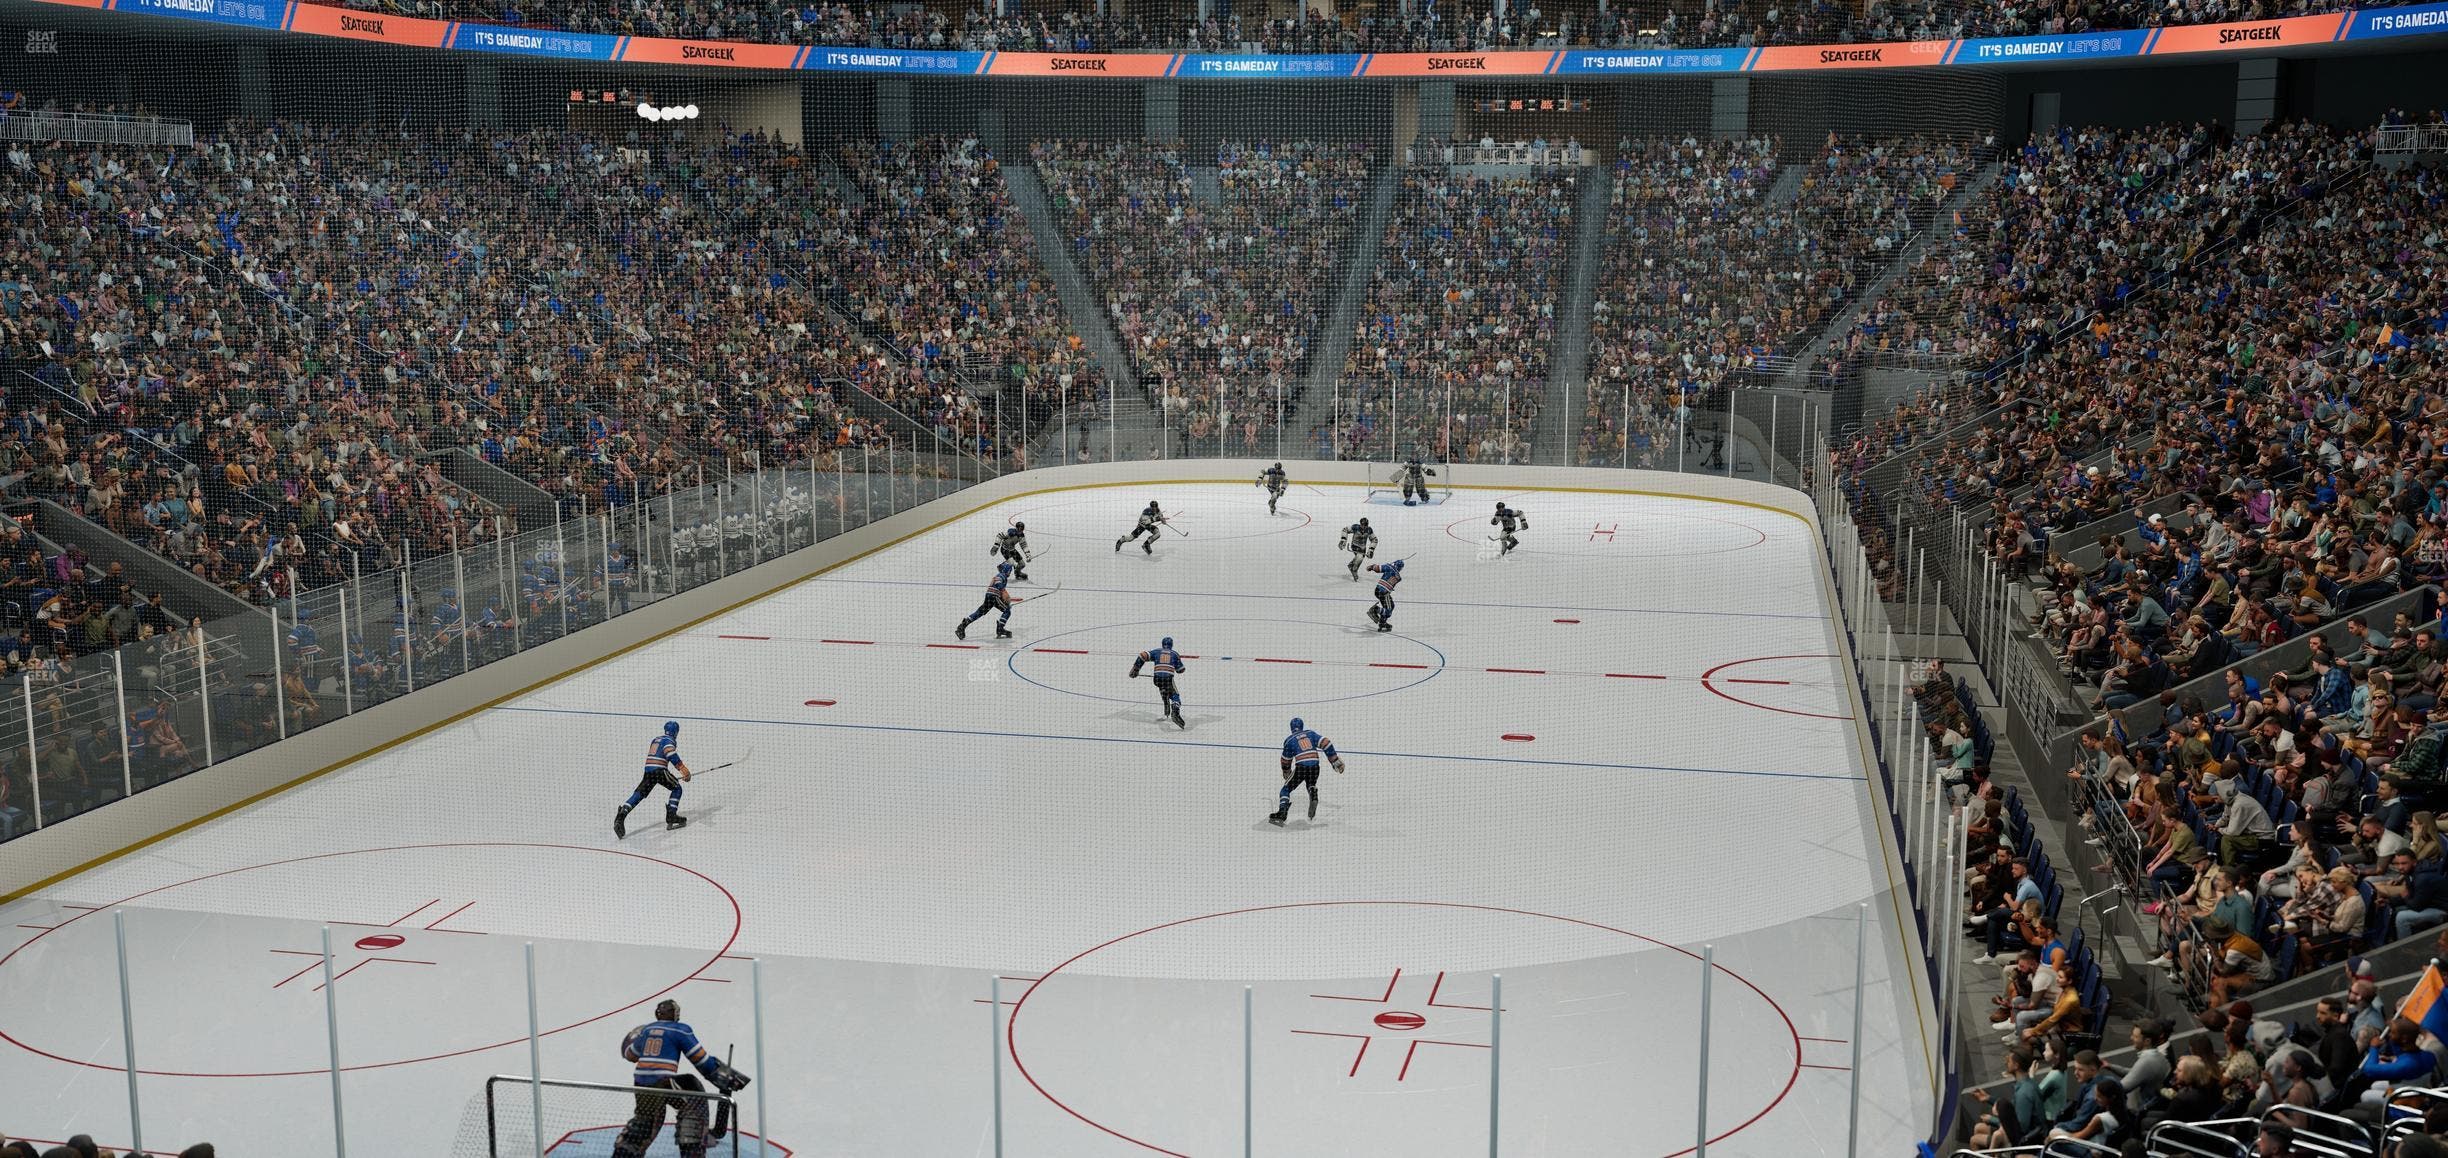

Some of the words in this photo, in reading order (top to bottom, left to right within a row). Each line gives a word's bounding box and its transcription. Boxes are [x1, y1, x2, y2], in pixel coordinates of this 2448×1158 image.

[218, 1, 245, 18] LET'S
[247, 4, 265, 20] GO!
[341, 15, 384, 35] SEATGEEK
[2371, 15, 2393, 31] IT'S
[475, 31, 494, 45] IT'S
[496, 34, 543, 49] GAMEDAY
[2219, 25, 2282, 44] SEATGEEK
[682, 45, 734, 61] SEATGEEK
[1980, 45, 2002, 57] IT'S
[2004, 41, 2064, 56] GAMEDAY
[2067, 39, 2100, 54] LET'S
[2101, 37, 2122, 51] GO!
[827, 53, 848, 65] IT'S
[850, 54, 902, 66] GAMEDAY
[1050, 57, 1106, 71] SEATGEEK
[1427, 57, 1486, 70] SEATGEEK
[1583, 56, 1605, 68] IT'S
[1607, 56, 1664, 67] GAMEDAY
[1667, 55, 1699, 67] LET'S
[1820, 49, 1882, 63] SEATGEEK
[1201, 60, 1222, 71] IT'S
[1224, 60, 1279, 71] GAMEDAY
